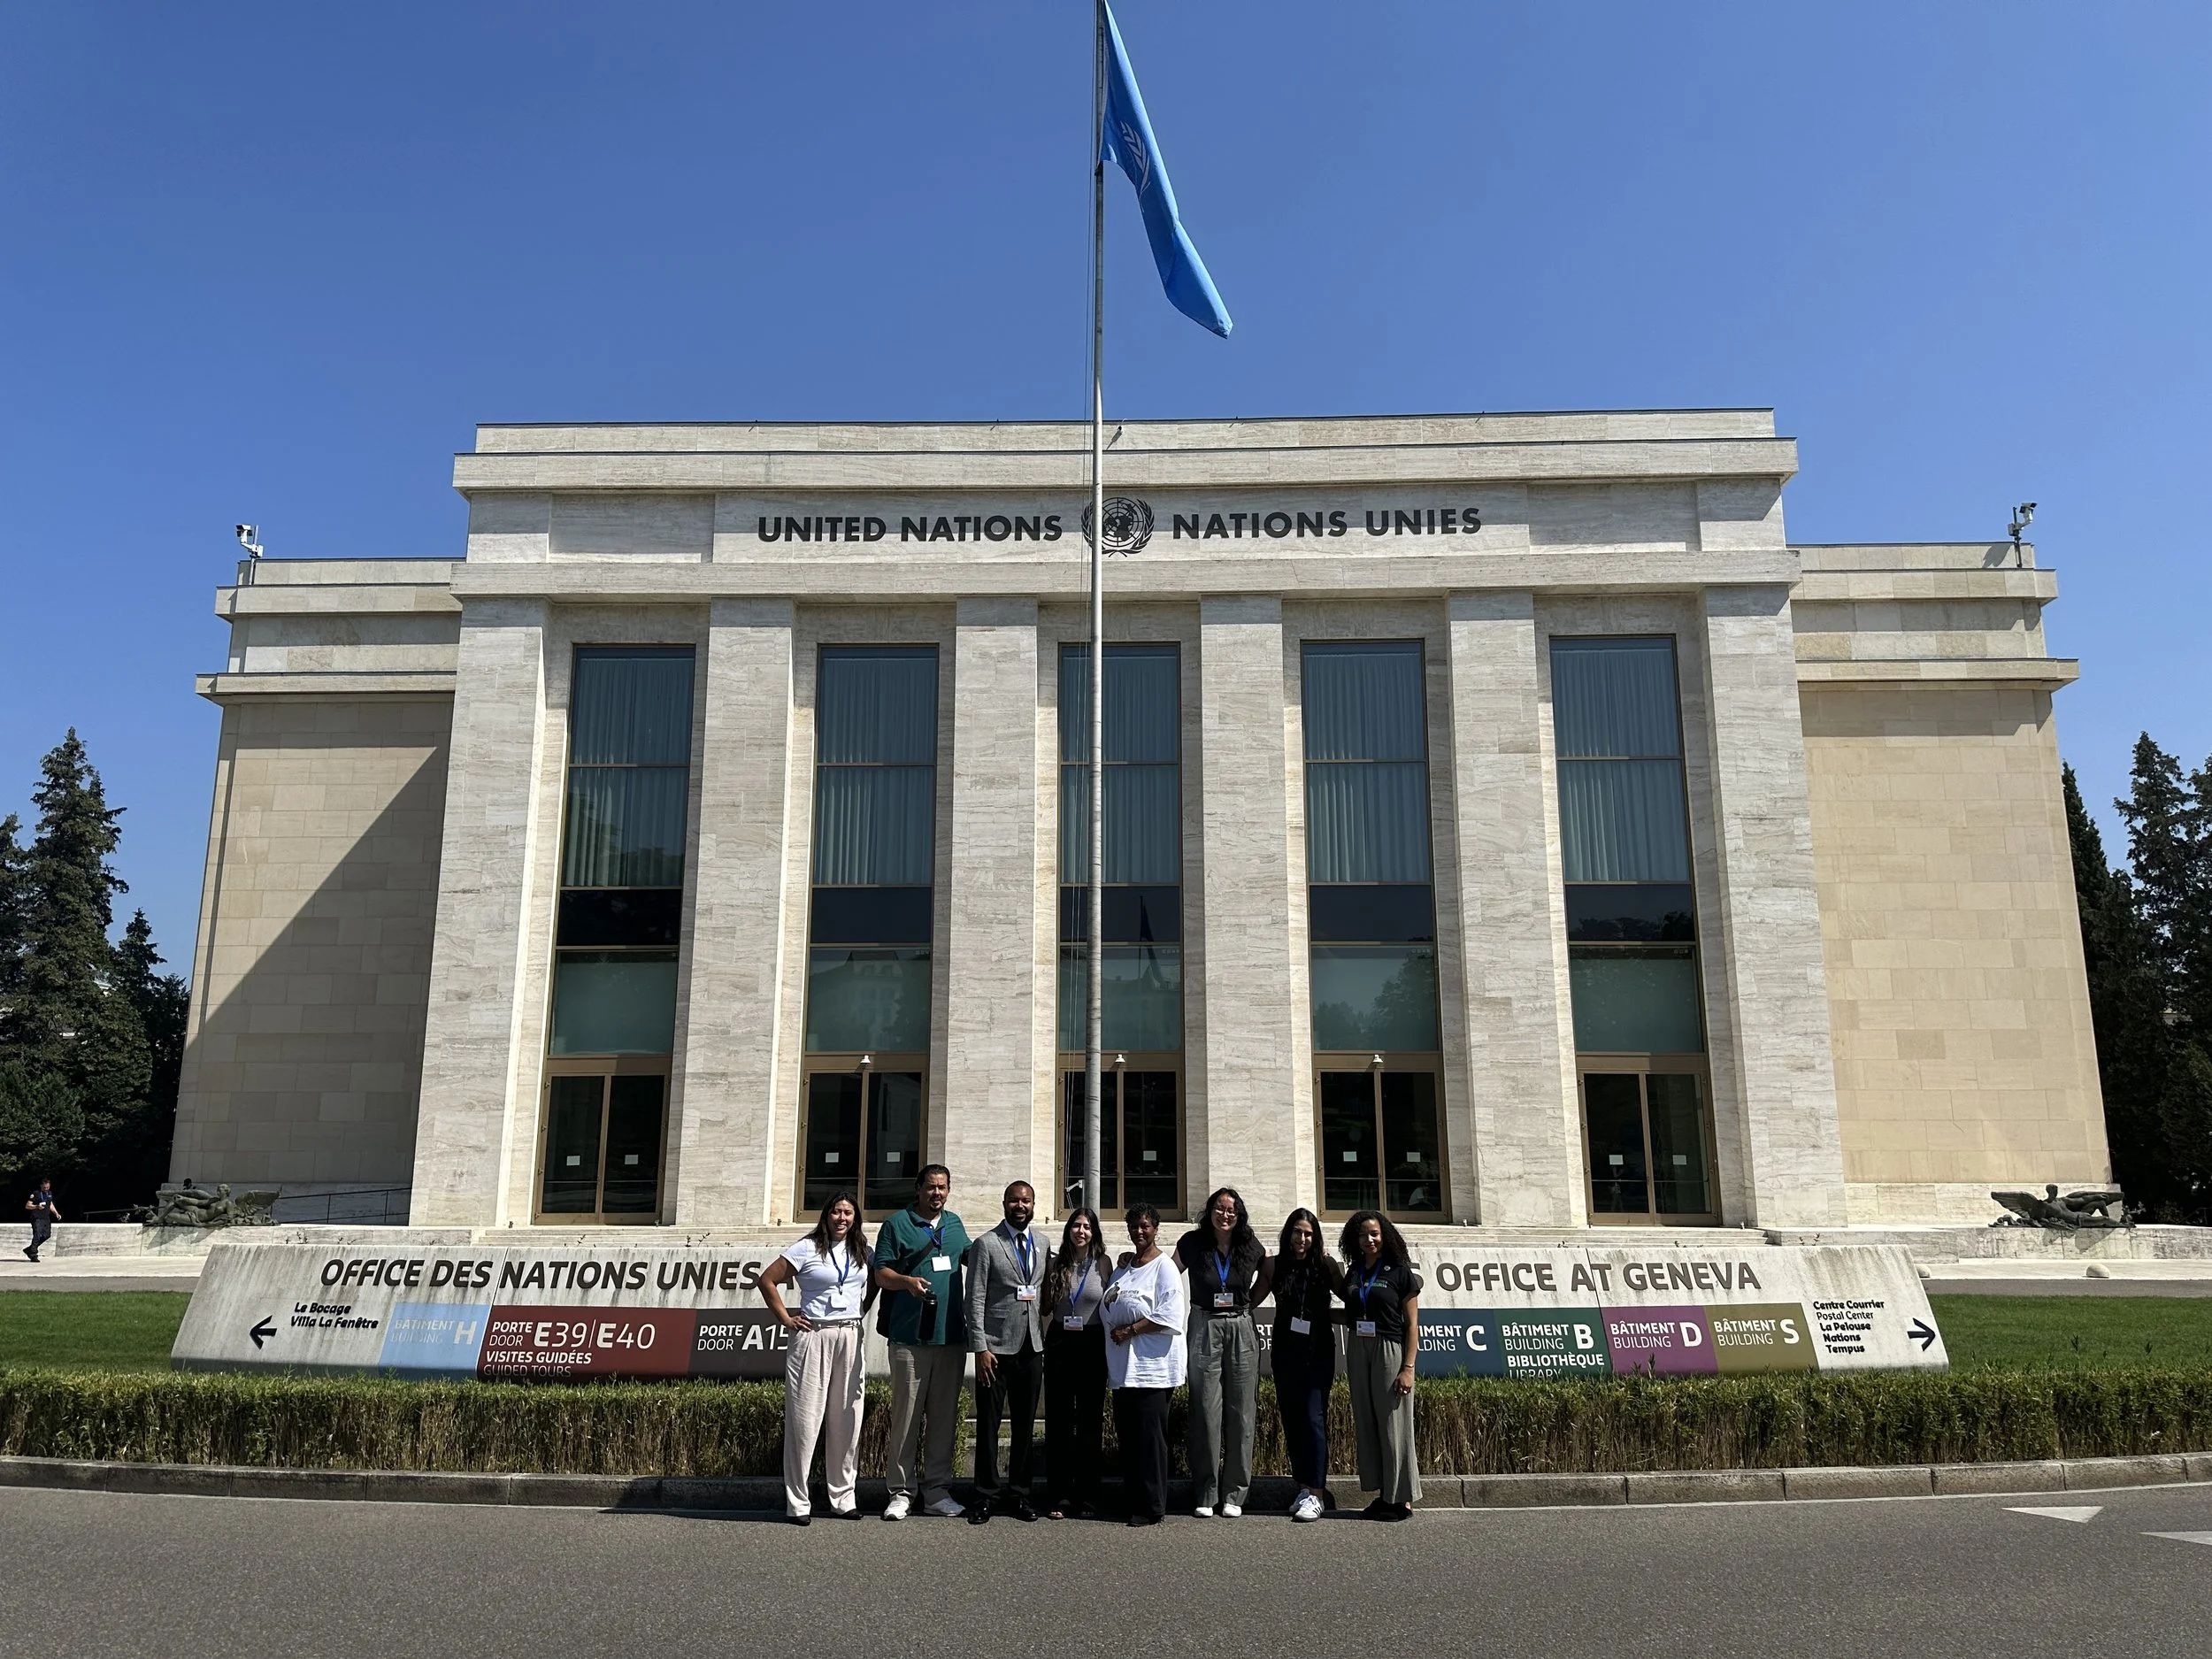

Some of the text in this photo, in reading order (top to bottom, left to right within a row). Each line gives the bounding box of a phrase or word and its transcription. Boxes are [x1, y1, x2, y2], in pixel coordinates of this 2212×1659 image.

[757, 515, 1063, 542] UNITED NATIONS
[1173, 507, 1482, 540] NATIONS UNIES
[320, 1258, 425, 1286] OFFICE
[429, 1259, 494, 1288] DES
[499, 1261, 648, 1290] NATIONS
[657, 1261, 761, 1290] UNIES
[1436, 1262, 1557, 1292] OFFICE
[1571, 1262, 1612, 1292] AT
[1622, 1262, 1762, 1291] GENEVA
[294, 1302, 352, 1316] Le Bocage
[1813, 1299, 1885, 1310] Centre Courrier
[1816, 1310, 1874, 1320] Postal Center
[290, 1316, 379, 1329] Villa La Fenêtre
[395, 1317, 456, 1331] BÂTIMENT
[491, 1321, 534, 1333] PORTE
[1502, 1322, 1570, 1337] BÂTIMENT
[1609, 1320, 1676, 1335] BÂTIMENT
[1713, 1318, 1777, 1333] BÂTIMENT
[1819, 1322, 1871, 1332] La Pelouse
[453, 1320, 478, 1345] H
[699, 1325, 744, 1337] PORTE
[1417, 1325, 1463, 1338] IMENT
[1466, 1325, 1487, 1351] C
[1573, 1324, 1594, 1349] B
[1679, 1321, 1703, 1348] D
[1779, 1318, 1801, 1344] S
[1823, 1333, 1862, 1343] Nations
[489, 1334, 524, 1347] DOOR
[697, 1338, 734, 1351] DOOR
[1417, 1339, 1456, 1351] LDING
[1504, 1337, 1564, 1350] BUILDING
[1613, 1334, 1672, 1349] BUILDING
[1717, 1333, 1774, 1347] BUILDING
[486, 1349, 593, 1364] VISITES GUIDÉES
[1825, 1344, 1865, 1355] Tempus
[1507, 1351, 1605, 1369] BIBLIOTHÈQUE
[483, 1363, 572, 1378] GUIDED TOURS
